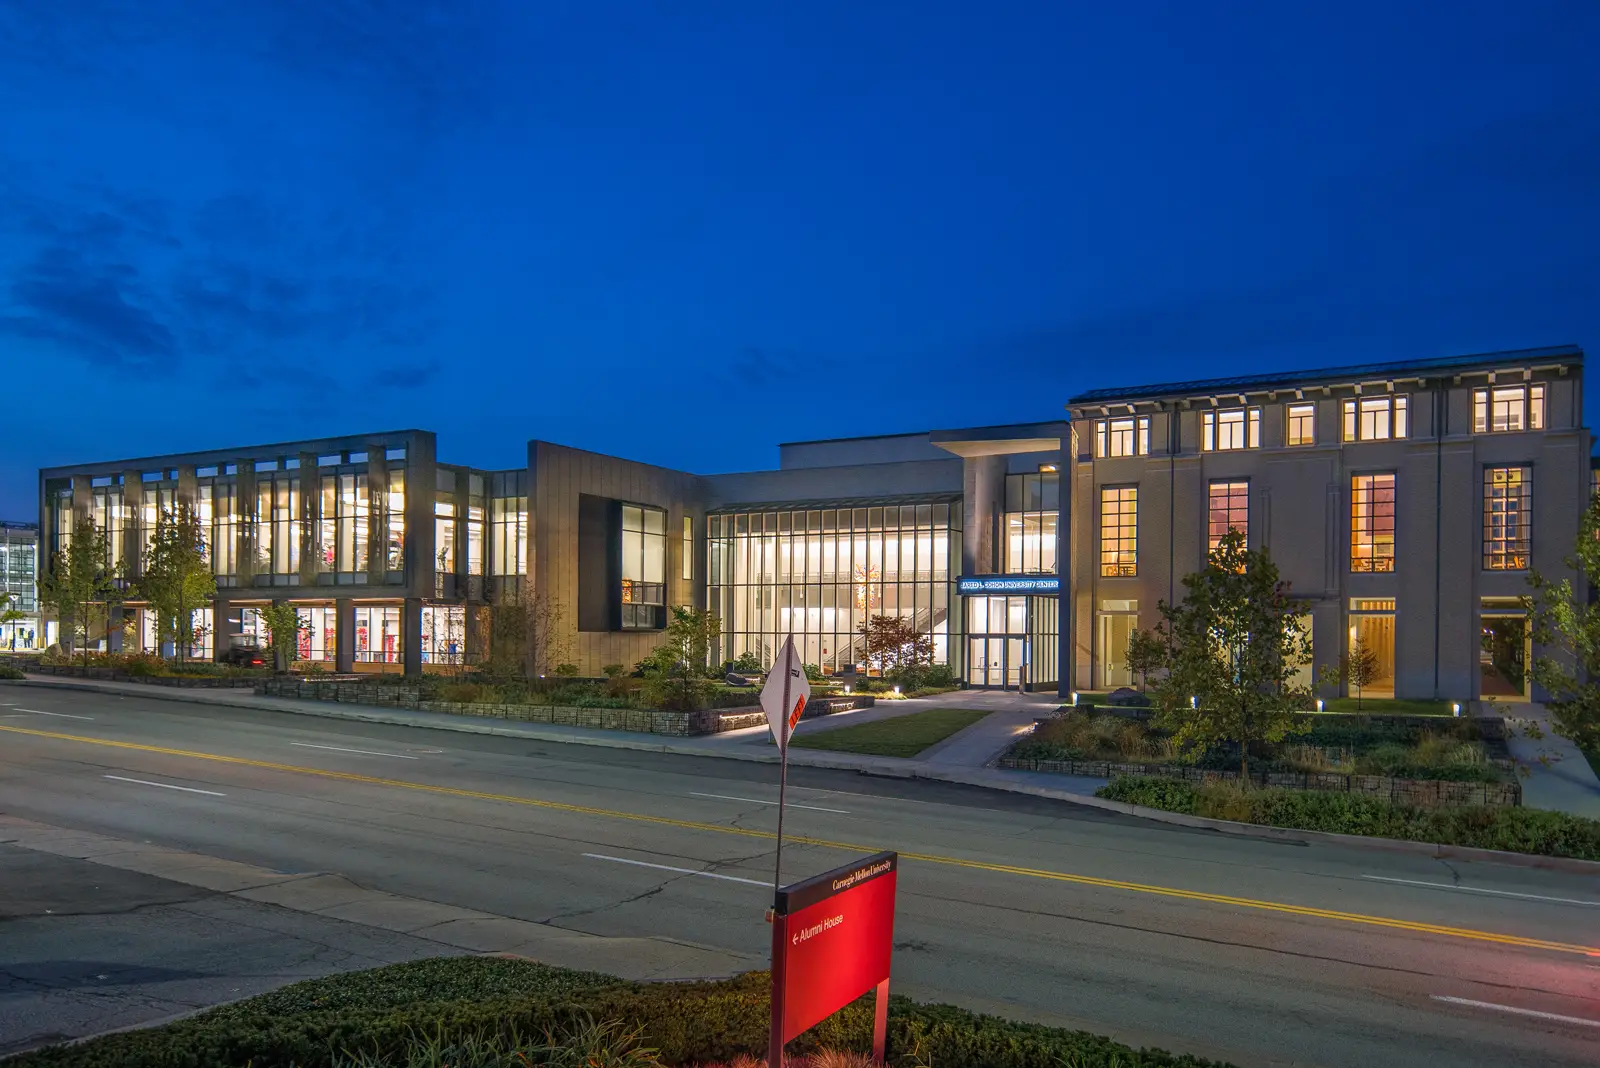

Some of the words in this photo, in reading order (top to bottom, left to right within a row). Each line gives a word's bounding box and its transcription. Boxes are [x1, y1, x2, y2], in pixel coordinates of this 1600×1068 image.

[832, 874, 855, 891] Carnegie
[855, 869, 871, 882] Mellon
[870, 860, 892, 876] University
[799, 920, 823, 943] Alumni
[823, 914, 844, 931] House
